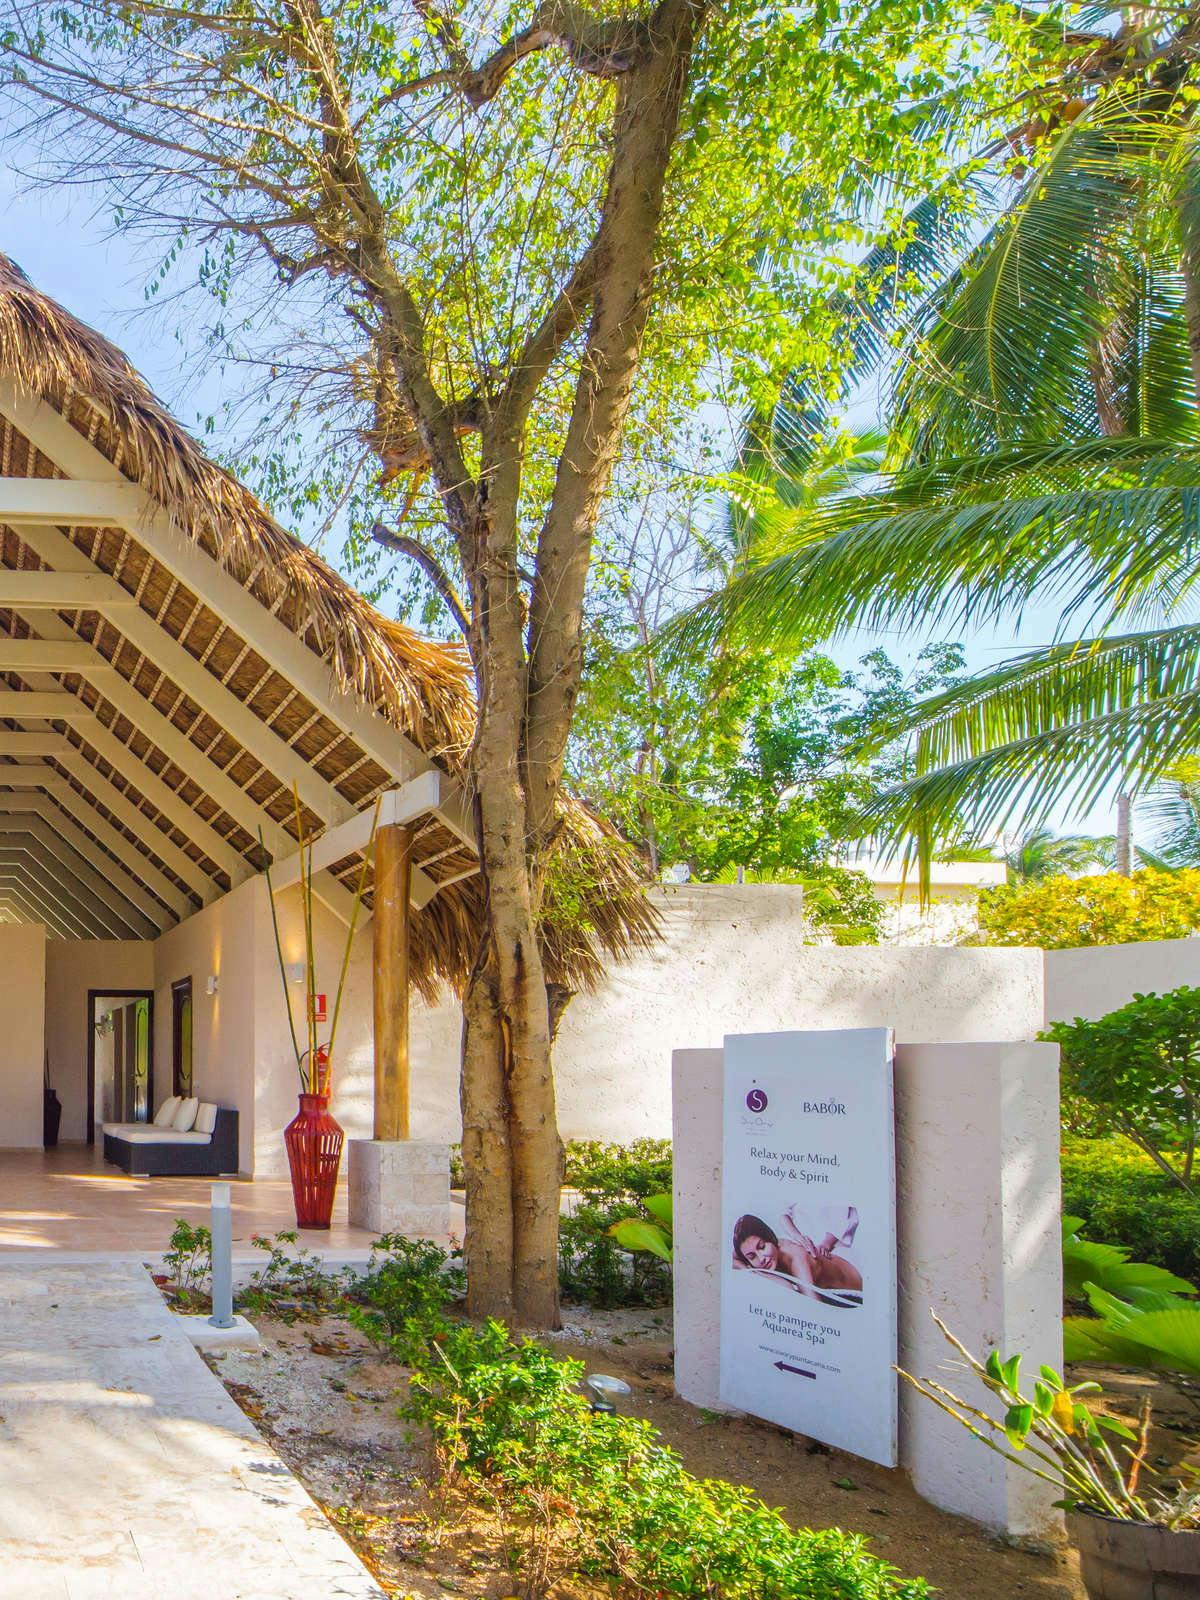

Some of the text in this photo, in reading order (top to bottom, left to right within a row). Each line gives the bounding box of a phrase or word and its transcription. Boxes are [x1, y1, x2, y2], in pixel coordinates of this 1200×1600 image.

[803, 1101, 847, 1115] BABOR
[750, 1147, 841, 1168] Relax your Mind,
[760, 1165, 829, 1184] Body & Spirit
[749, 1303, 841, 1338] Let us pamper you
[762, 1320, 825, 1345] Aquarea Spa
